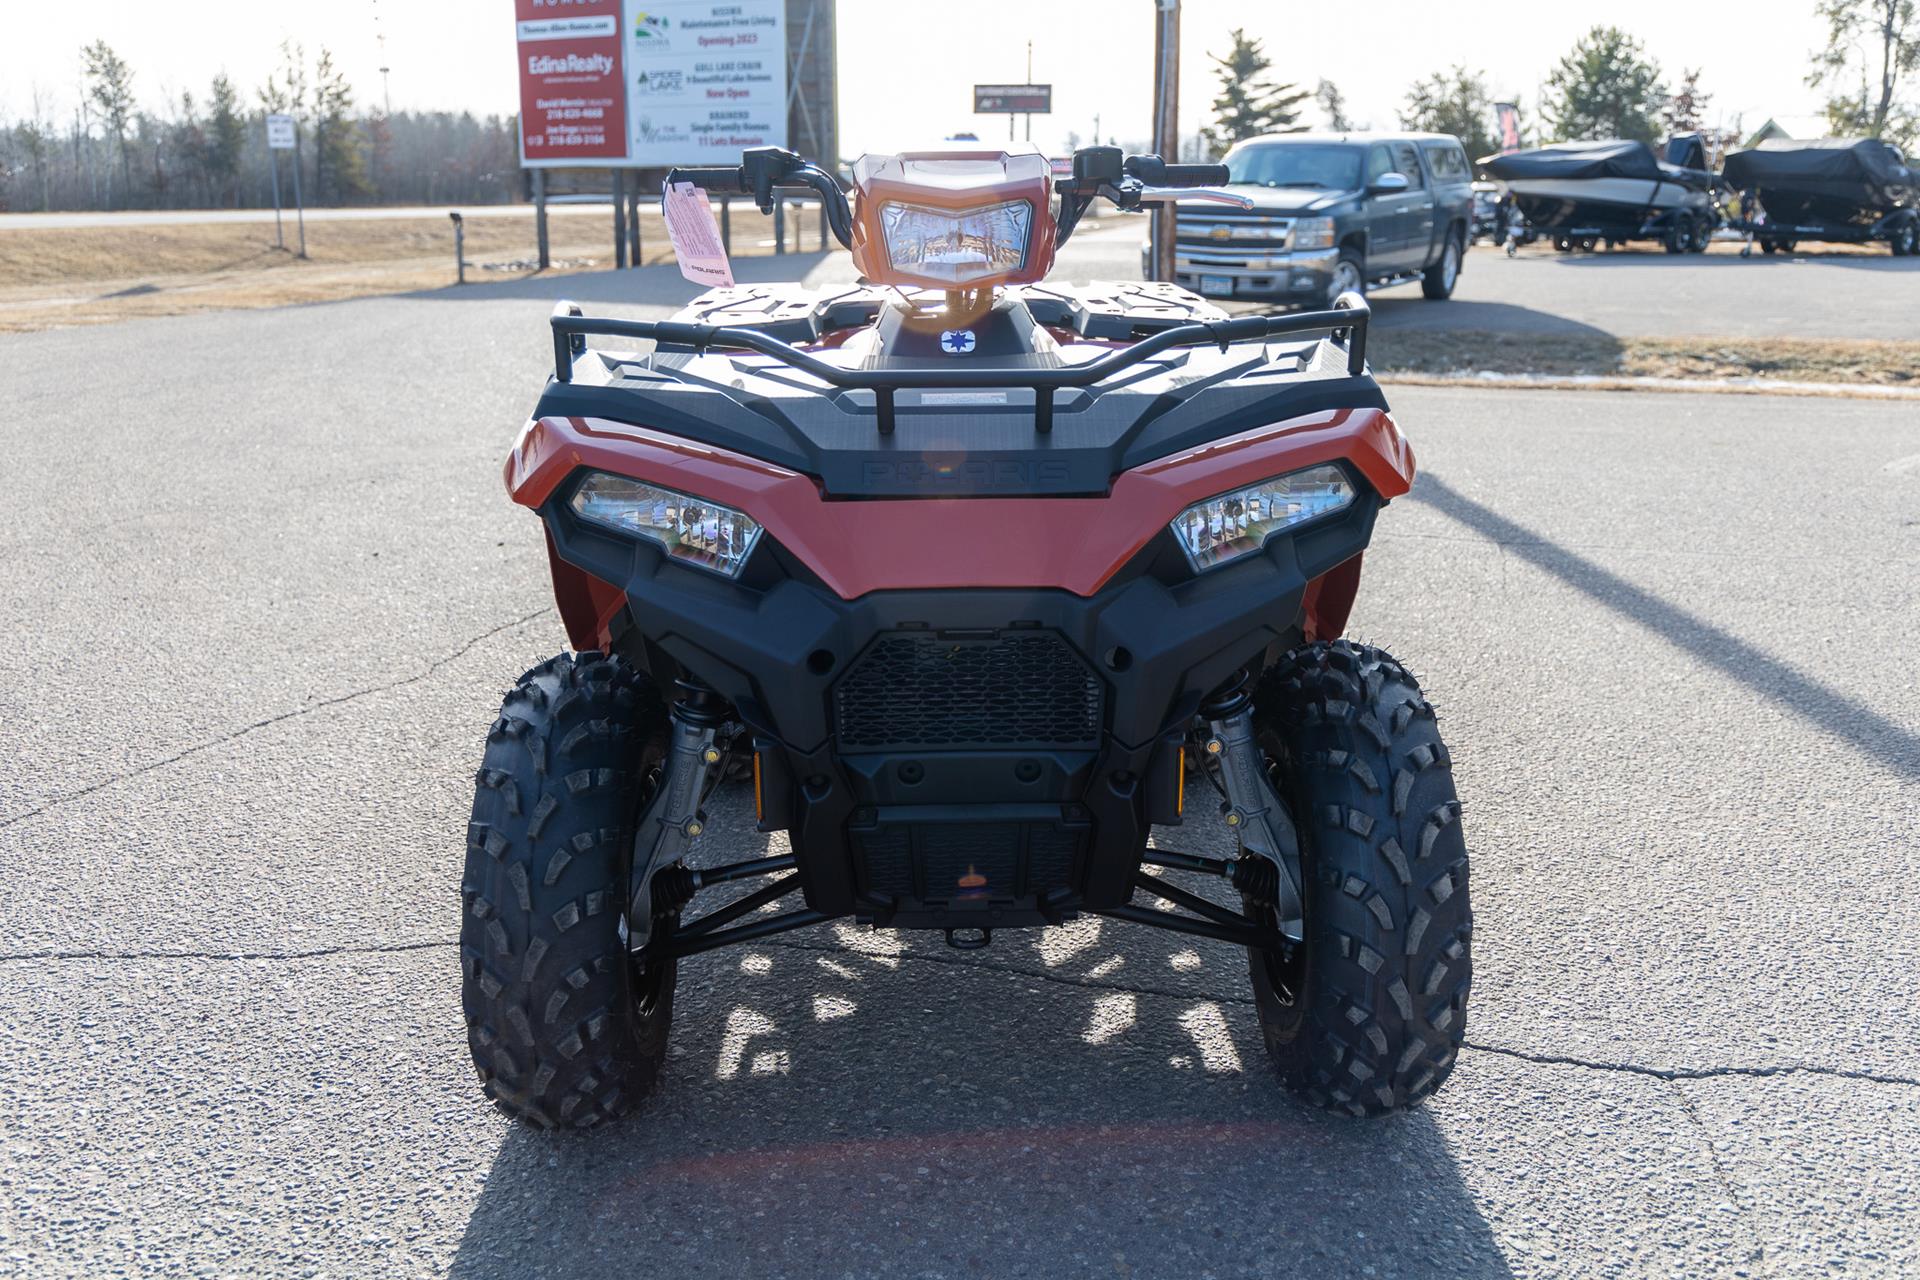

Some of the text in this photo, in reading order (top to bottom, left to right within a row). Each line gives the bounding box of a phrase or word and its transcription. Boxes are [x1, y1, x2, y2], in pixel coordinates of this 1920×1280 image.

[680, 16, 776, 29] Maintenance Free Living
[697, 33, 758, 47] Opening 2023
[715, 61, 735, 71] LAKE
[737, 60, 763, 70] CHAIN
[692, 74, 726, 84] Beautiful
[728, 74, 744, 83] Lake
[746, 73, 772, 82] Homes
[649, 80, 682, 91] LAKE
[706, 87, 750, 100] Now Open
[709, 110, 750, 121] BRAINERD
[691, 120, 770, 134] Single Family Homes
[699, 135, 764, 147] 11 Lots Remain
[691, 264, 727, 277] POLARIS
[863, 459, 1071, 489] POLARIS
